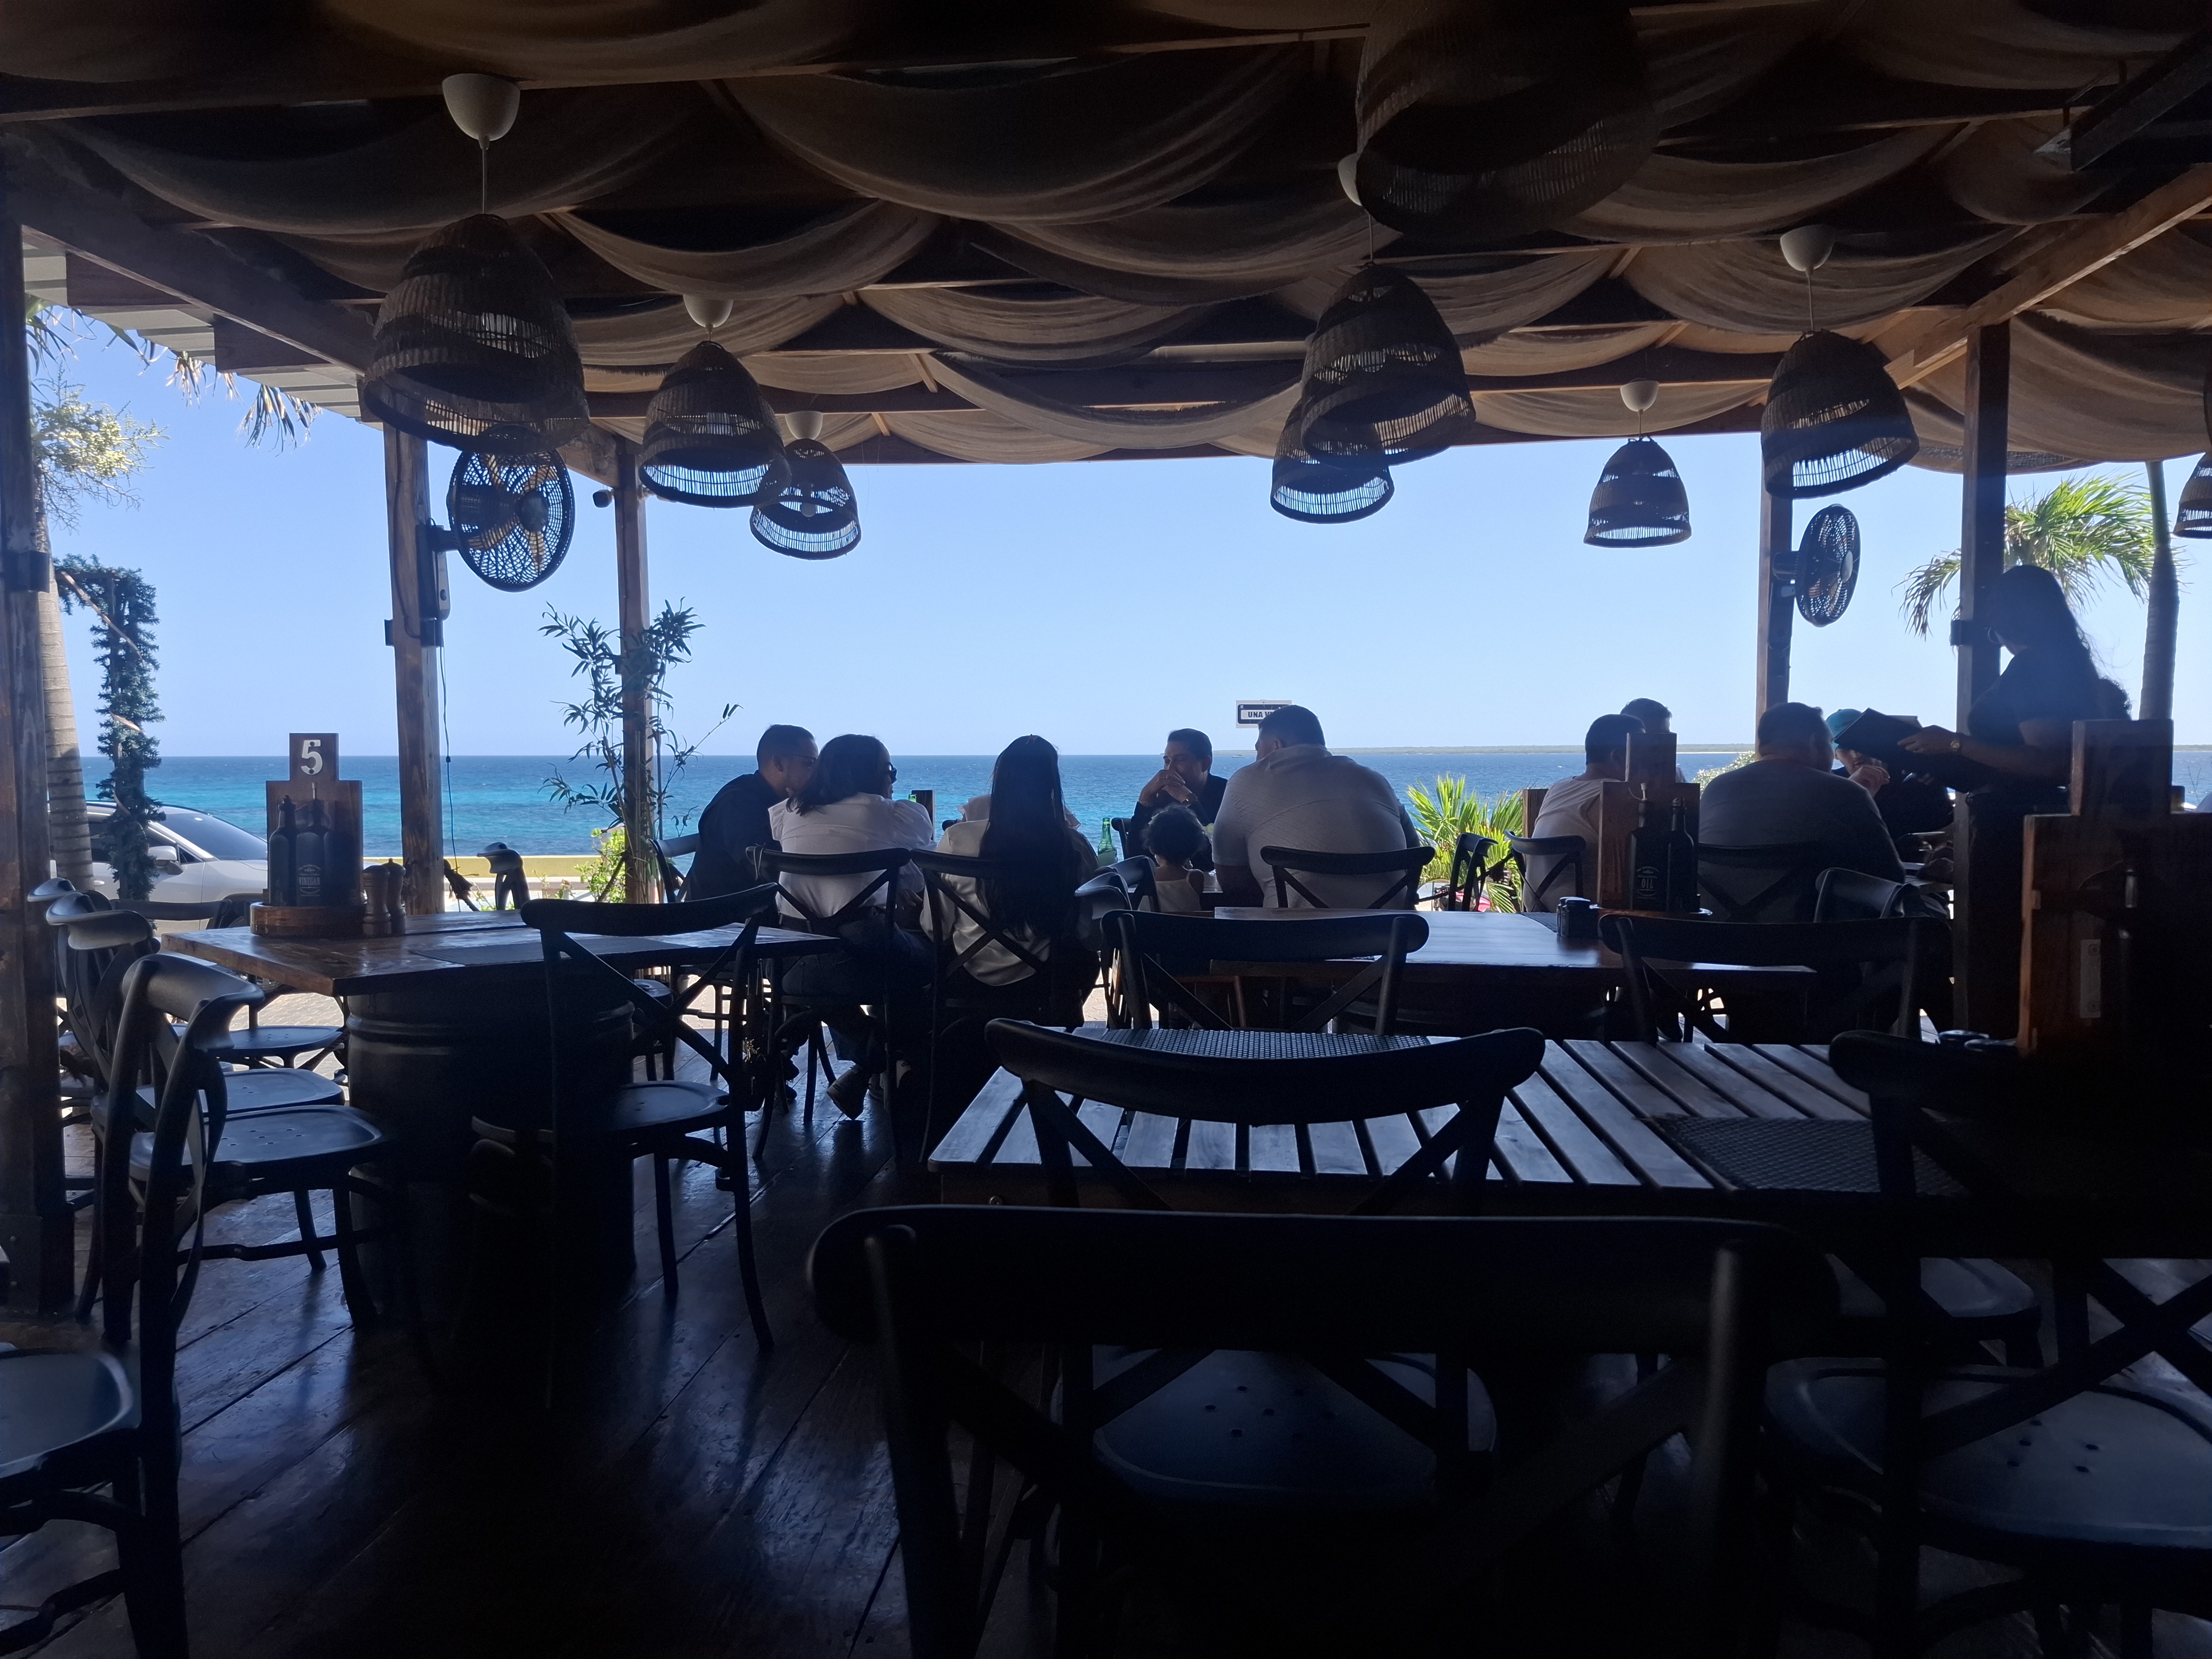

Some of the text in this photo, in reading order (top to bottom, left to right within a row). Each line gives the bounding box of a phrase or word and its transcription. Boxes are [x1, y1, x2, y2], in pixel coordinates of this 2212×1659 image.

[301, 740, 323, 775] 5
[298, 877, 320, 885] VINEGAR
[1641, 878, 1654, 889] OIL
